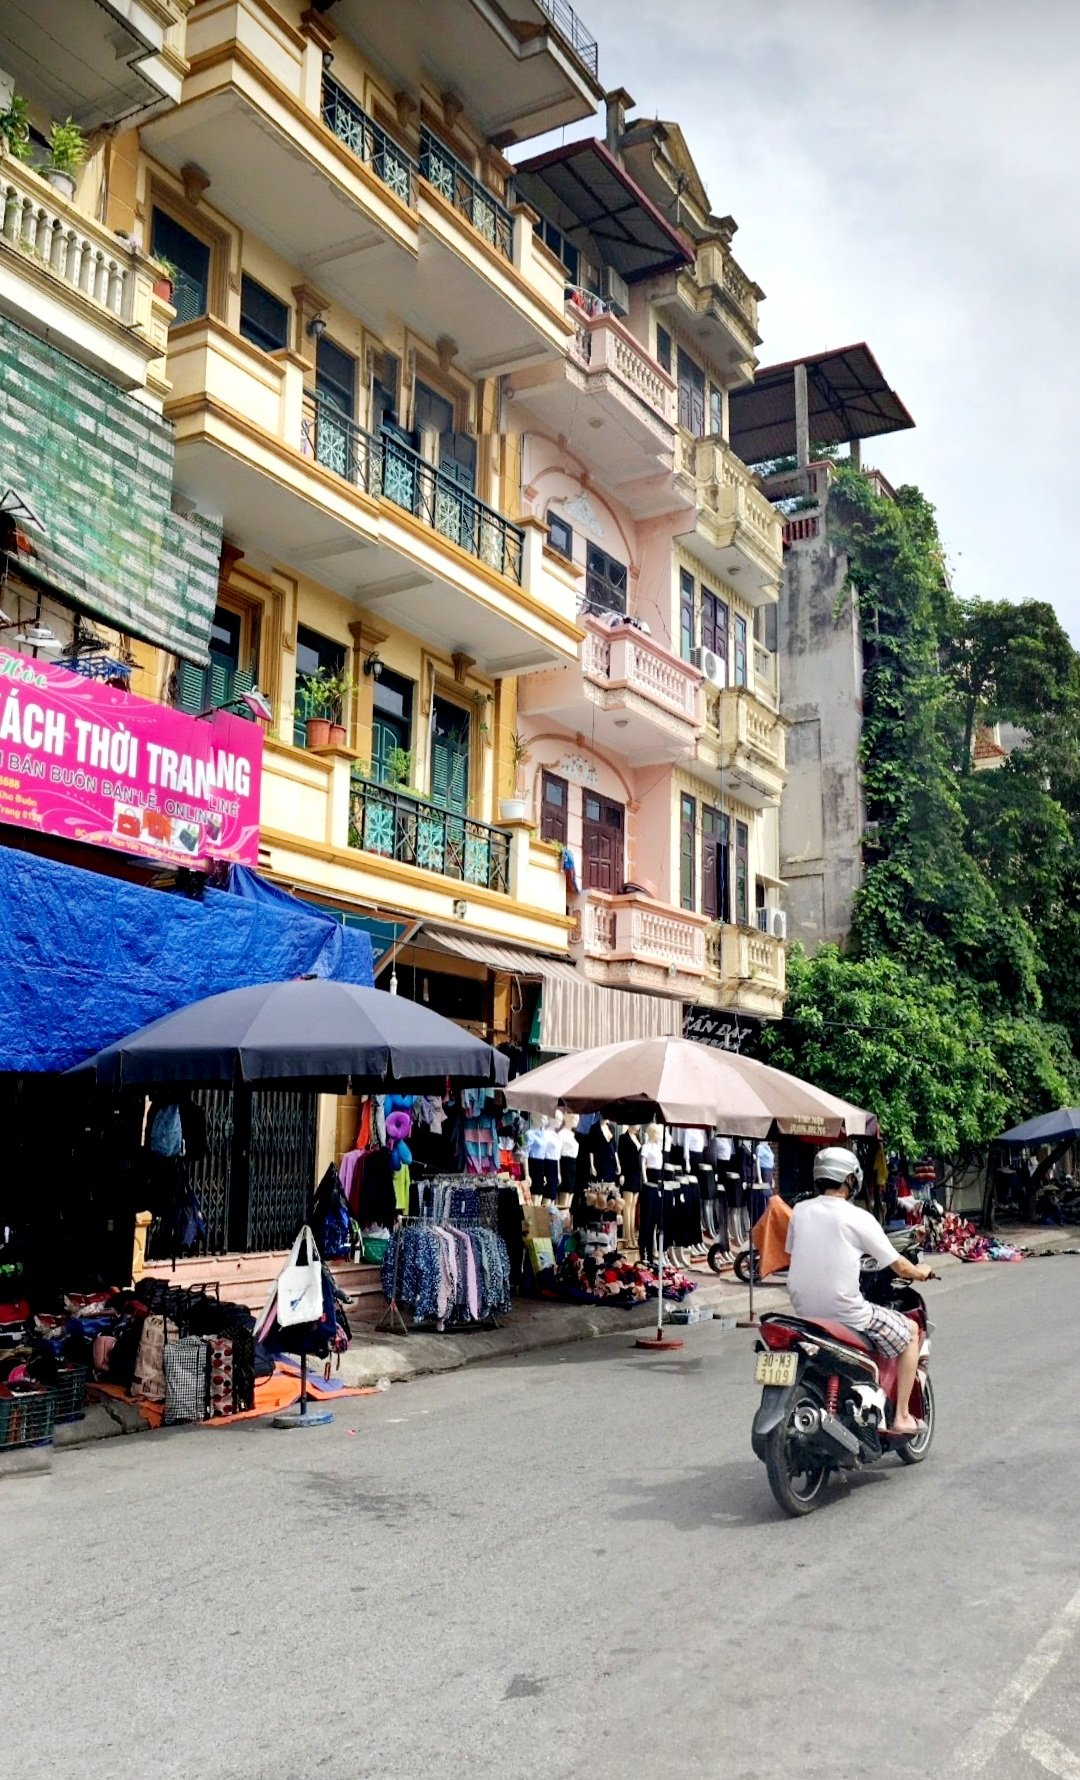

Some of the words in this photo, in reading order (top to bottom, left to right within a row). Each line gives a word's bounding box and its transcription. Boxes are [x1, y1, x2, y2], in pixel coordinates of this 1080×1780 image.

[0, 687, 66, 757] ÁCH
[74, 718, 139, 779] THỜI
[8, 753, 46, 779] BÁN
[50, 765, 98, 794] BUÔN
[102, 779, 134, 804] BÁN
